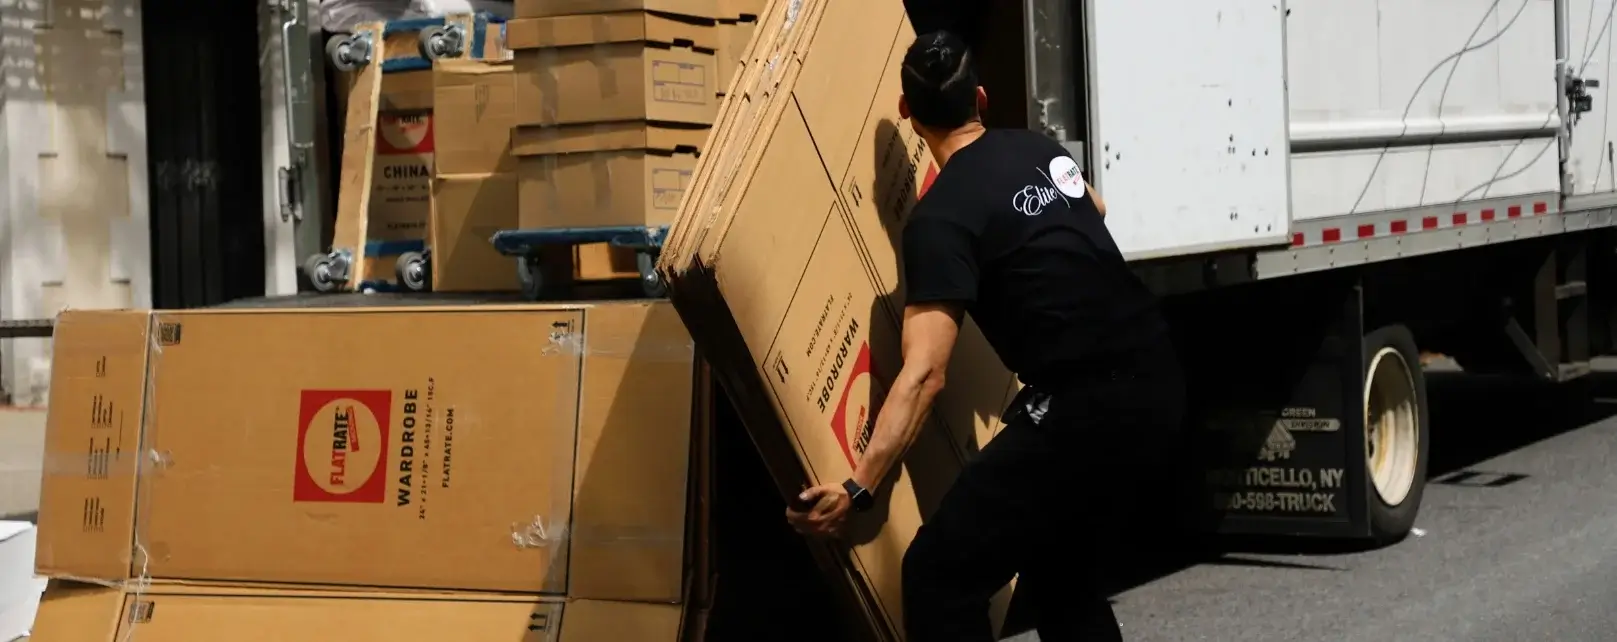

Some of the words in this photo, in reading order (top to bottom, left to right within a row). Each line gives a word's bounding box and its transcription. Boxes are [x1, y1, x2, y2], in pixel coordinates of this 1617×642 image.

[383, 165, 429, 179] CHINA
[1013, 185, 1057, 216] Elite
[807, 294, 834, 357] FLATRATE.COM
[817, 317, 859, 413] WARDROBE
[1281, 407, 1316, 418] GREEN
[331, 412, 348, 485] FLATRATE
[398, 389, 418, 507] WARDROBE
[442, 408, 454, 489] FLATRATE.COM
[1206, 467, 1317, 490] TICELLO,
[1320, 468, 1344, 488] NY
[1214, 492, 1336, 512] 0-598-TRUCK
